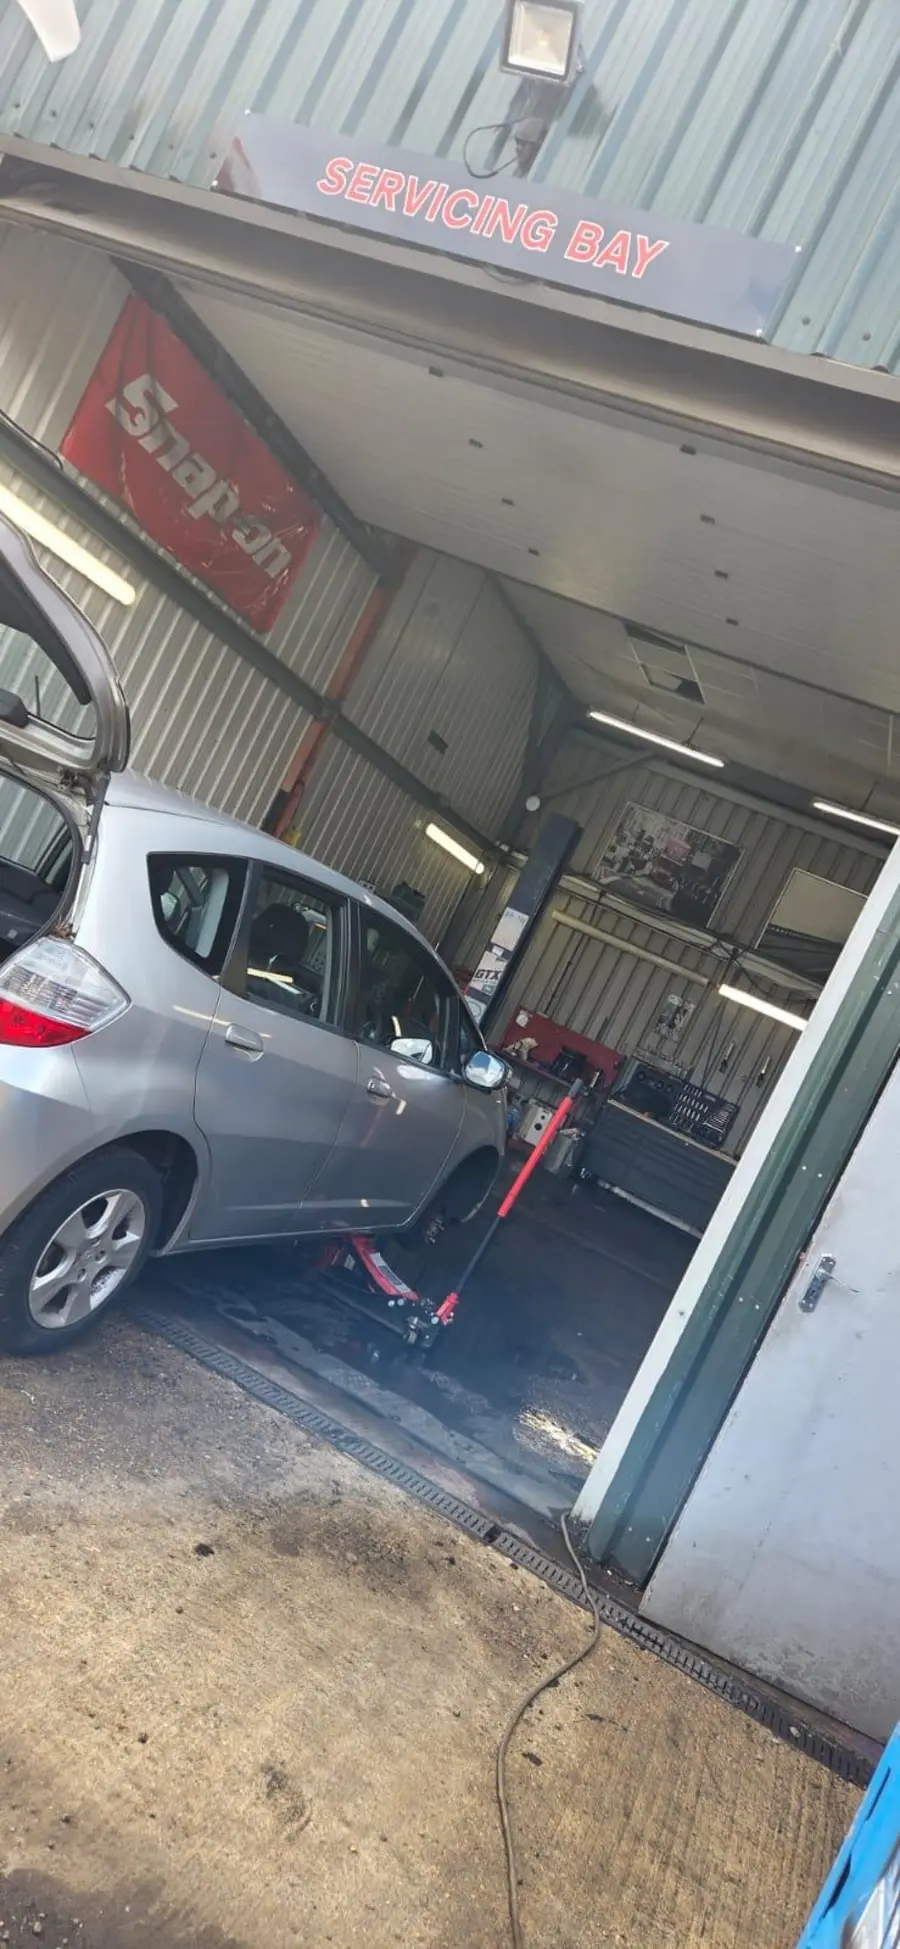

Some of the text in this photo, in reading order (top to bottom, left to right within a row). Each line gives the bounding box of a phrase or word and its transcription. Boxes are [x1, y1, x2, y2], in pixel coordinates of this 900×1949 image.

[317, 156, 670, 279] SERVICING BAY
[475, 969, 503, 980] GTX
